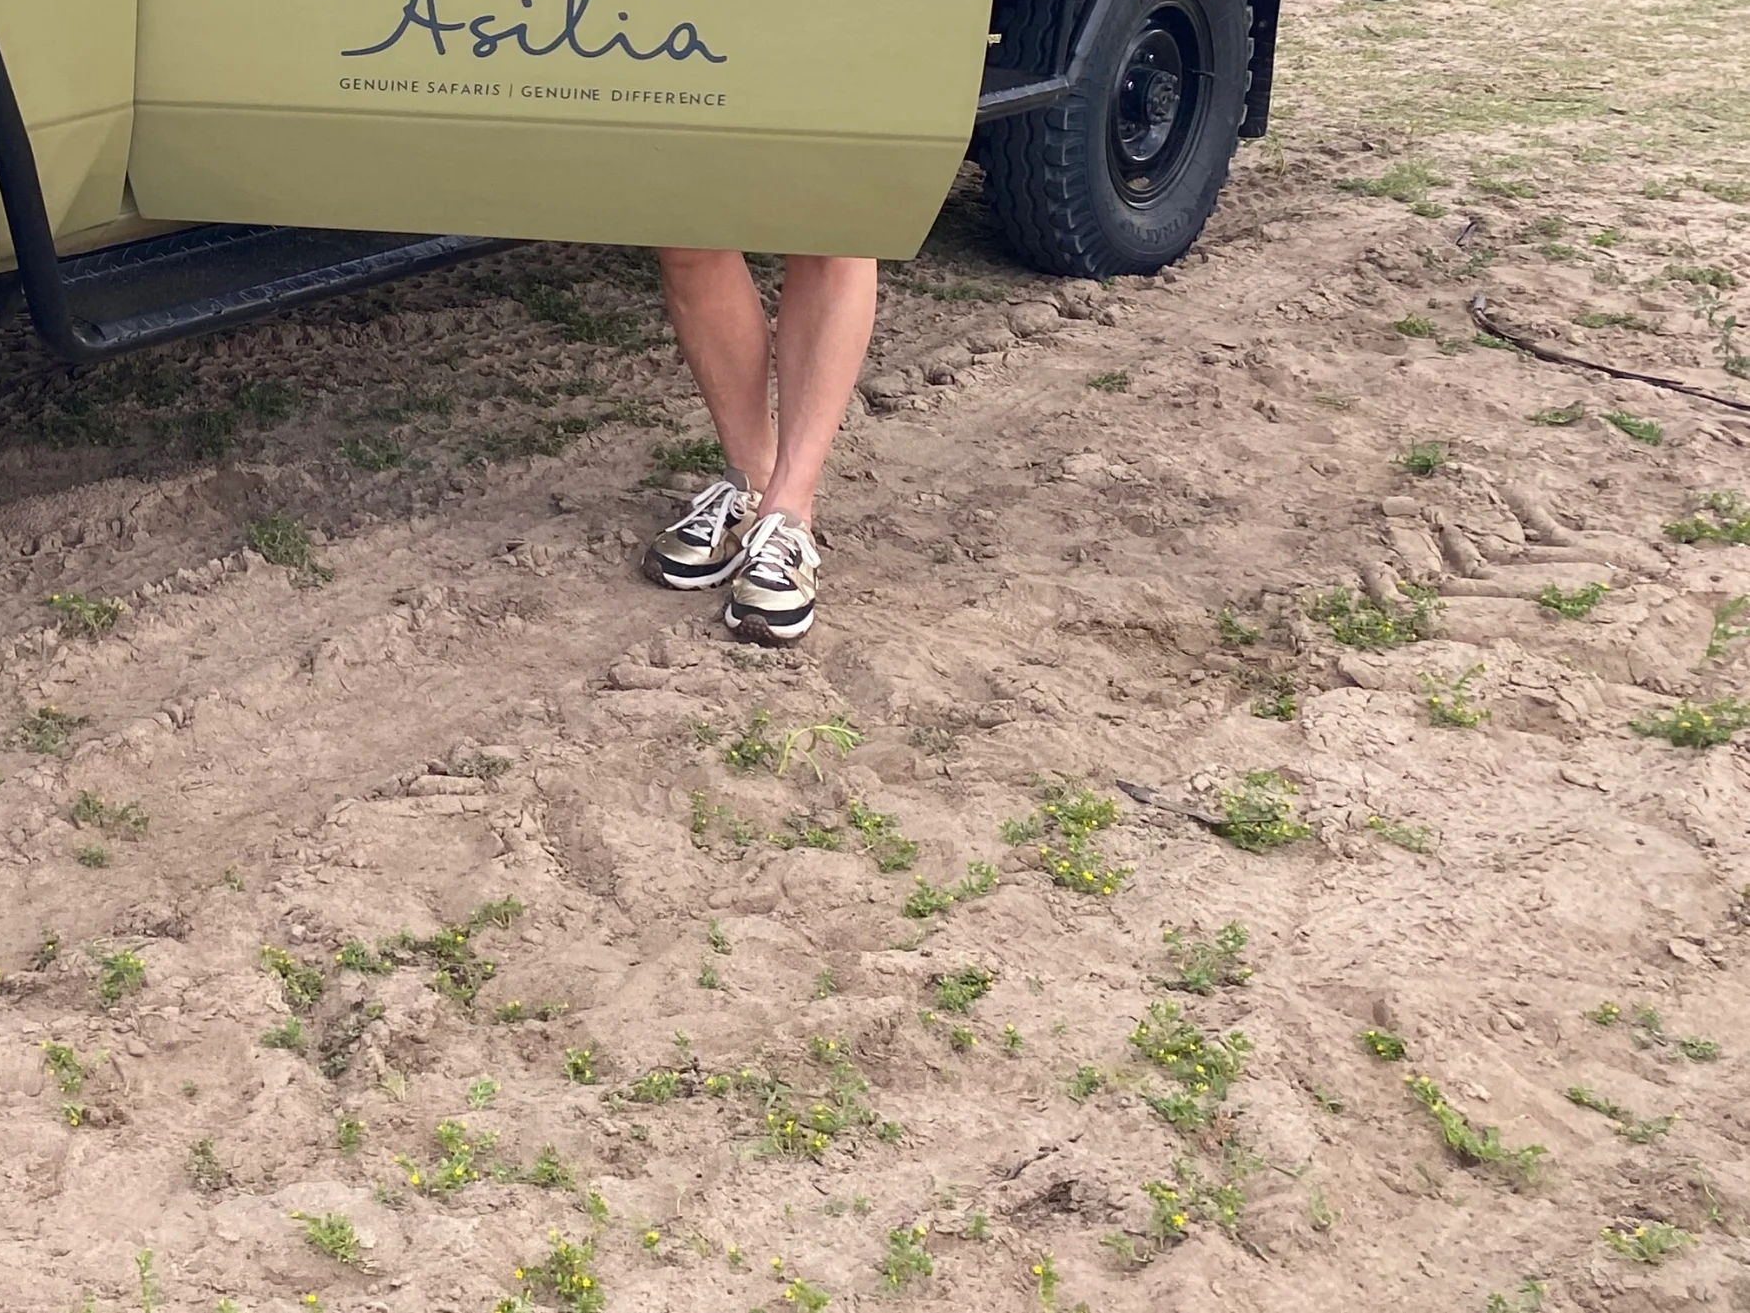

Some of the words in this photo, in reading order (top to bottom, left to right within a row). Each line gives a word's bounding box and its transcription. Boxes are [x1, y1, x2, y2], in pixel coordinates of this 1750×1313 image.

[339, 77, 420, 94] GENUINE
[427, 81, 501, 97] SAFARIS
[520, 85, 601, 102] GENUINE
[610, 90, 728, 107] DIFFERENCE
